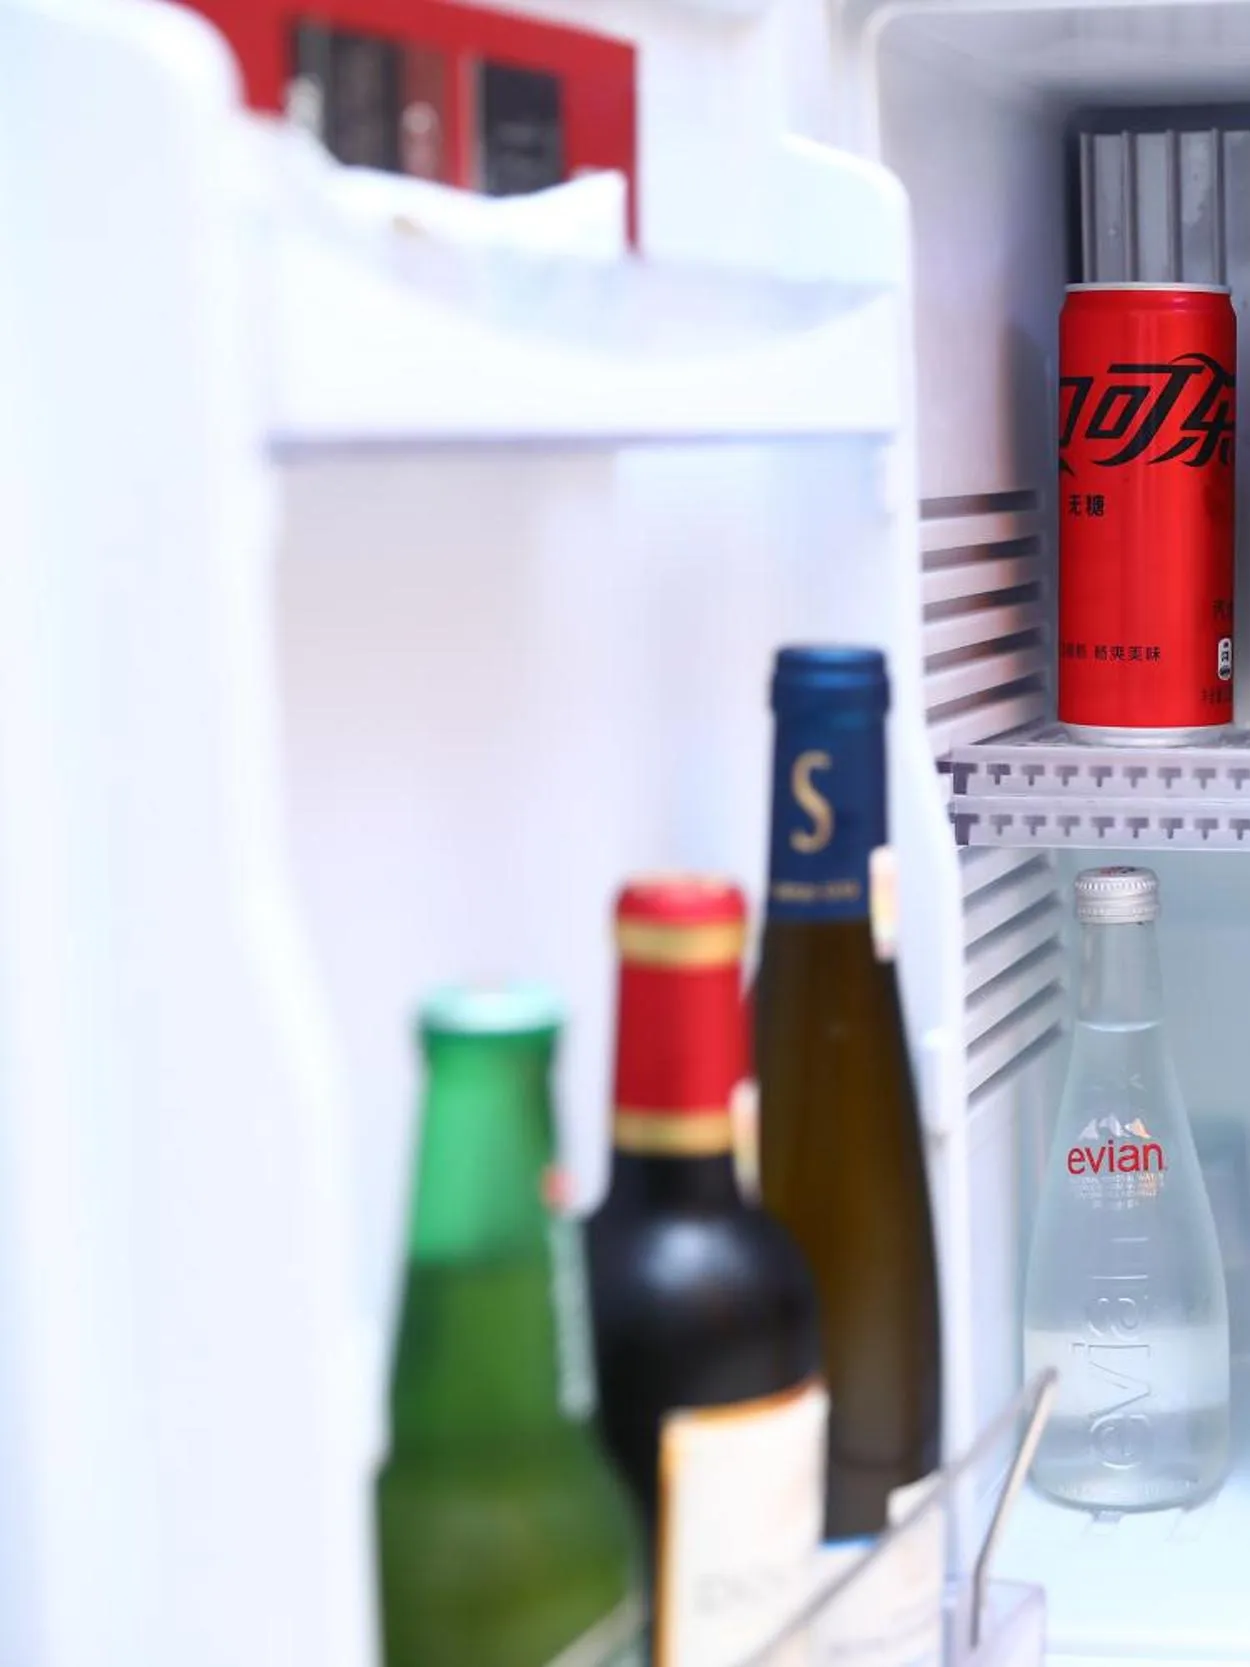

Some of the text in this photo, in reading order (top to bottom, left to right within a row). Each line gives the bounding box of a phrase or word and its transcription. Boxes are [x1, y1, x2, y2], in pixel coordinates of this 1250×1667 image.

[1068, 495, 1105, 517] 无糖
[789, 749, 835, 854] S
[1067, 1139, 1163, 1175] evian
